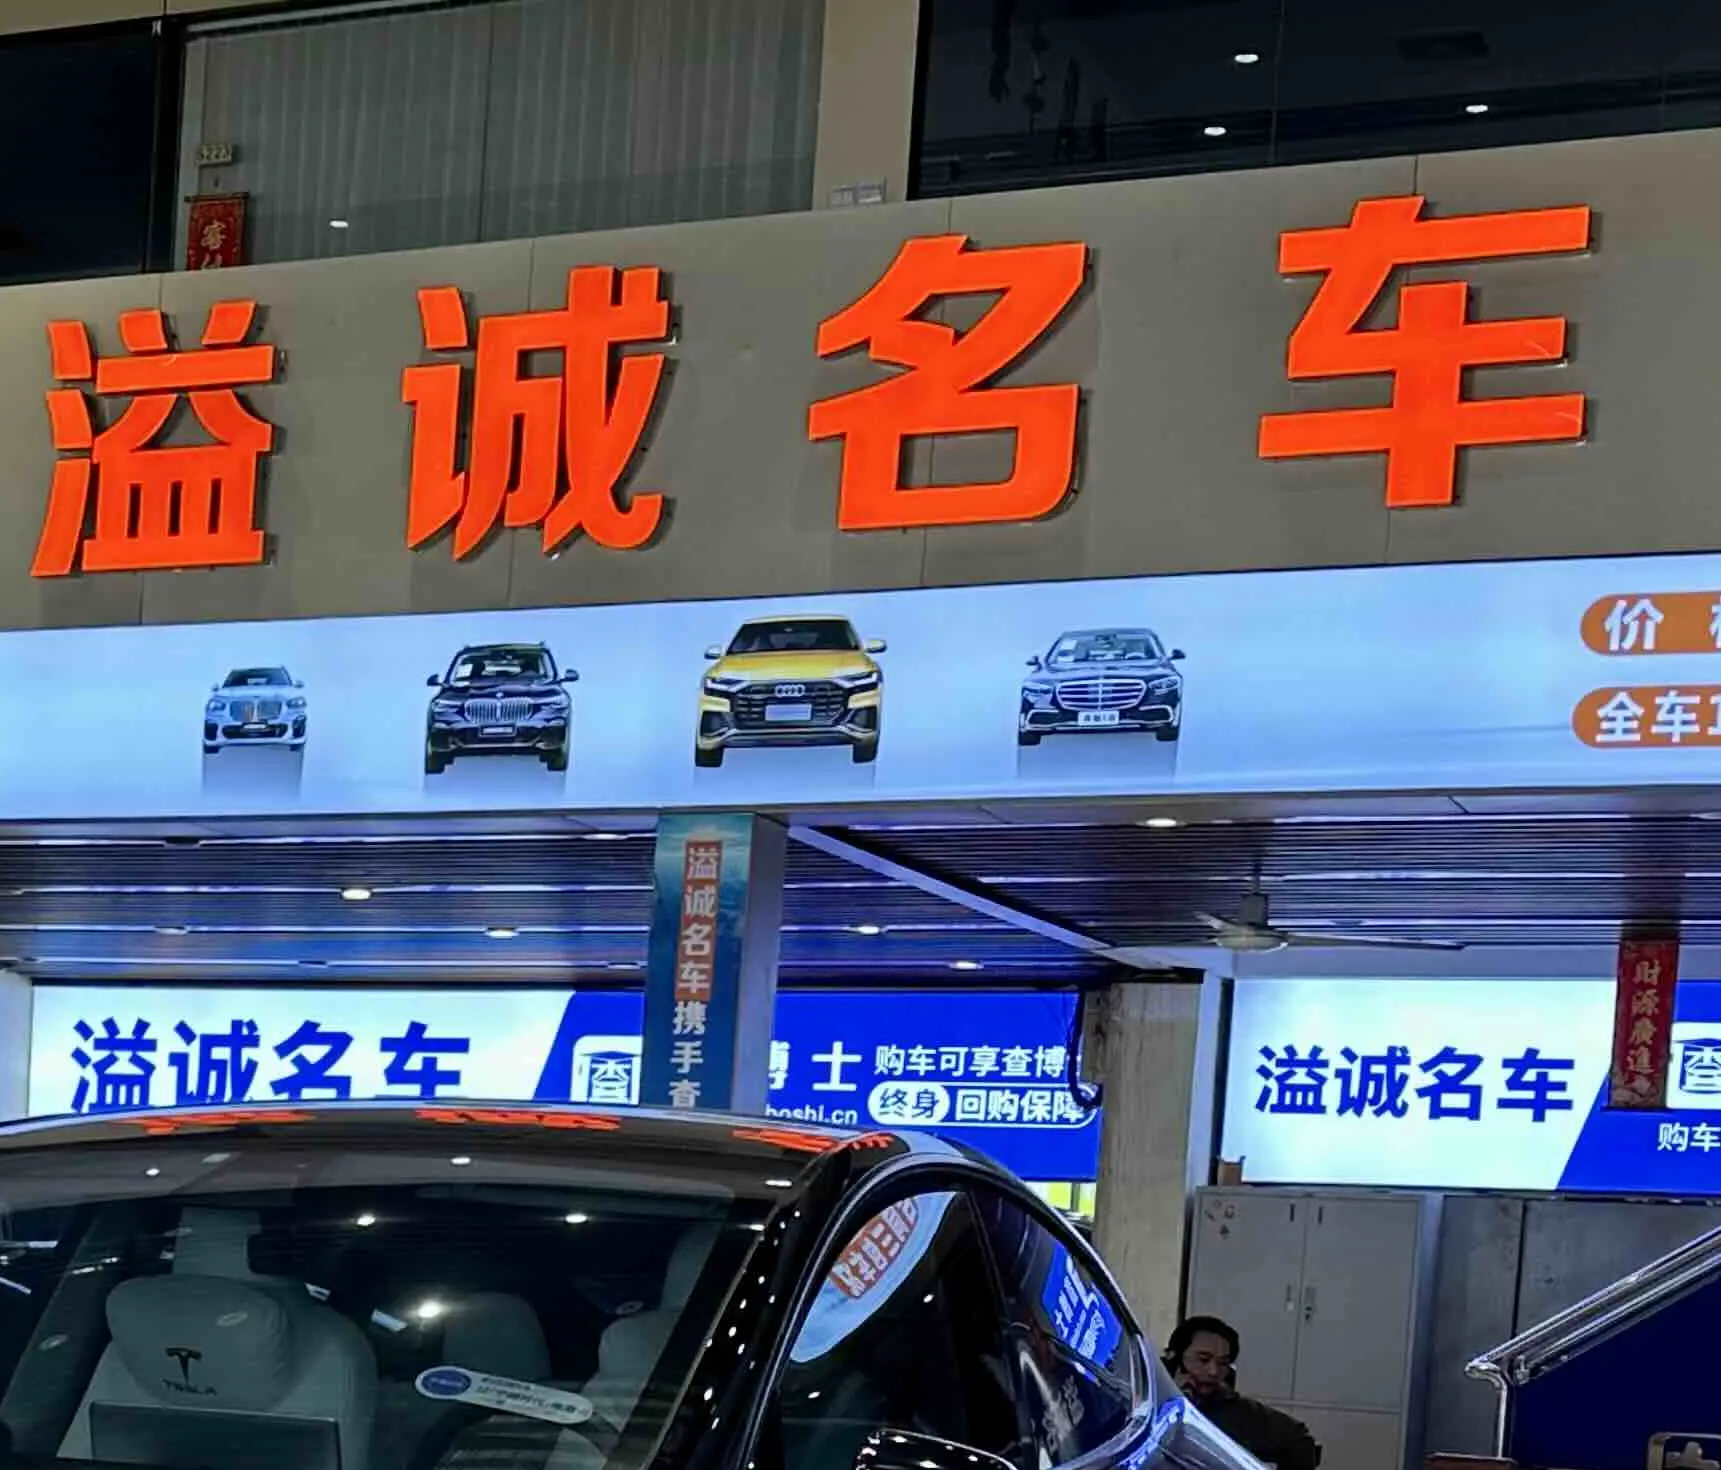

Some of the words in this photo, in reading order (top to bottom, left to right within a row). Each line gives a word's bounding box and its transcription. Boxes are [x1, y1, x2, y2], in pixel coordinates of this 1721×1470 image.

[30, 195, 1592, 577] 溢诚名车
[70, 1017, 469, 1114] 溢诚名车
[878, 1087, 941, 1119] 终身
[1254, 1046, 1576, 1122] 溢诚名车
